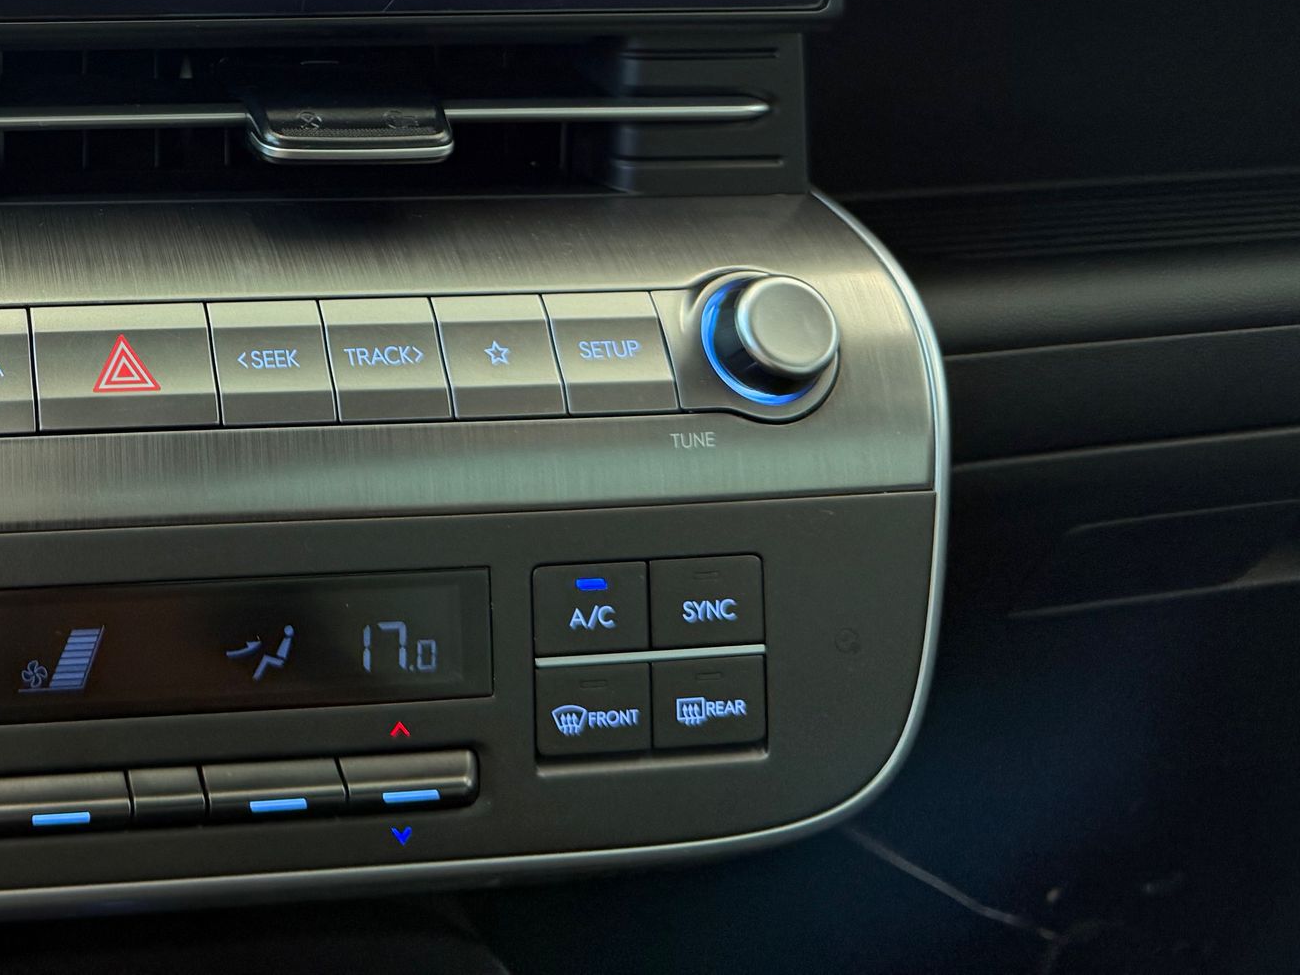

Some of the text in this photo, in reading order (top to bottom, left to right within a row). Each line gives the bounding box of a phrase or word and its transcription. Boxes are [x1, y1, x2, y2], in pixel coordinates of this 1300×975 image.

[578, 339, 642, 360] SETUP
[670, 431, 717, 451] TUNE
[569, 605, 616, 630] A/C
[682, 599, 738, 623] SYNC
[363, 621, 437, 673] 17.0
[588, 709, 640, 727] FRONT
[706, 699, 747, 717] REAR
